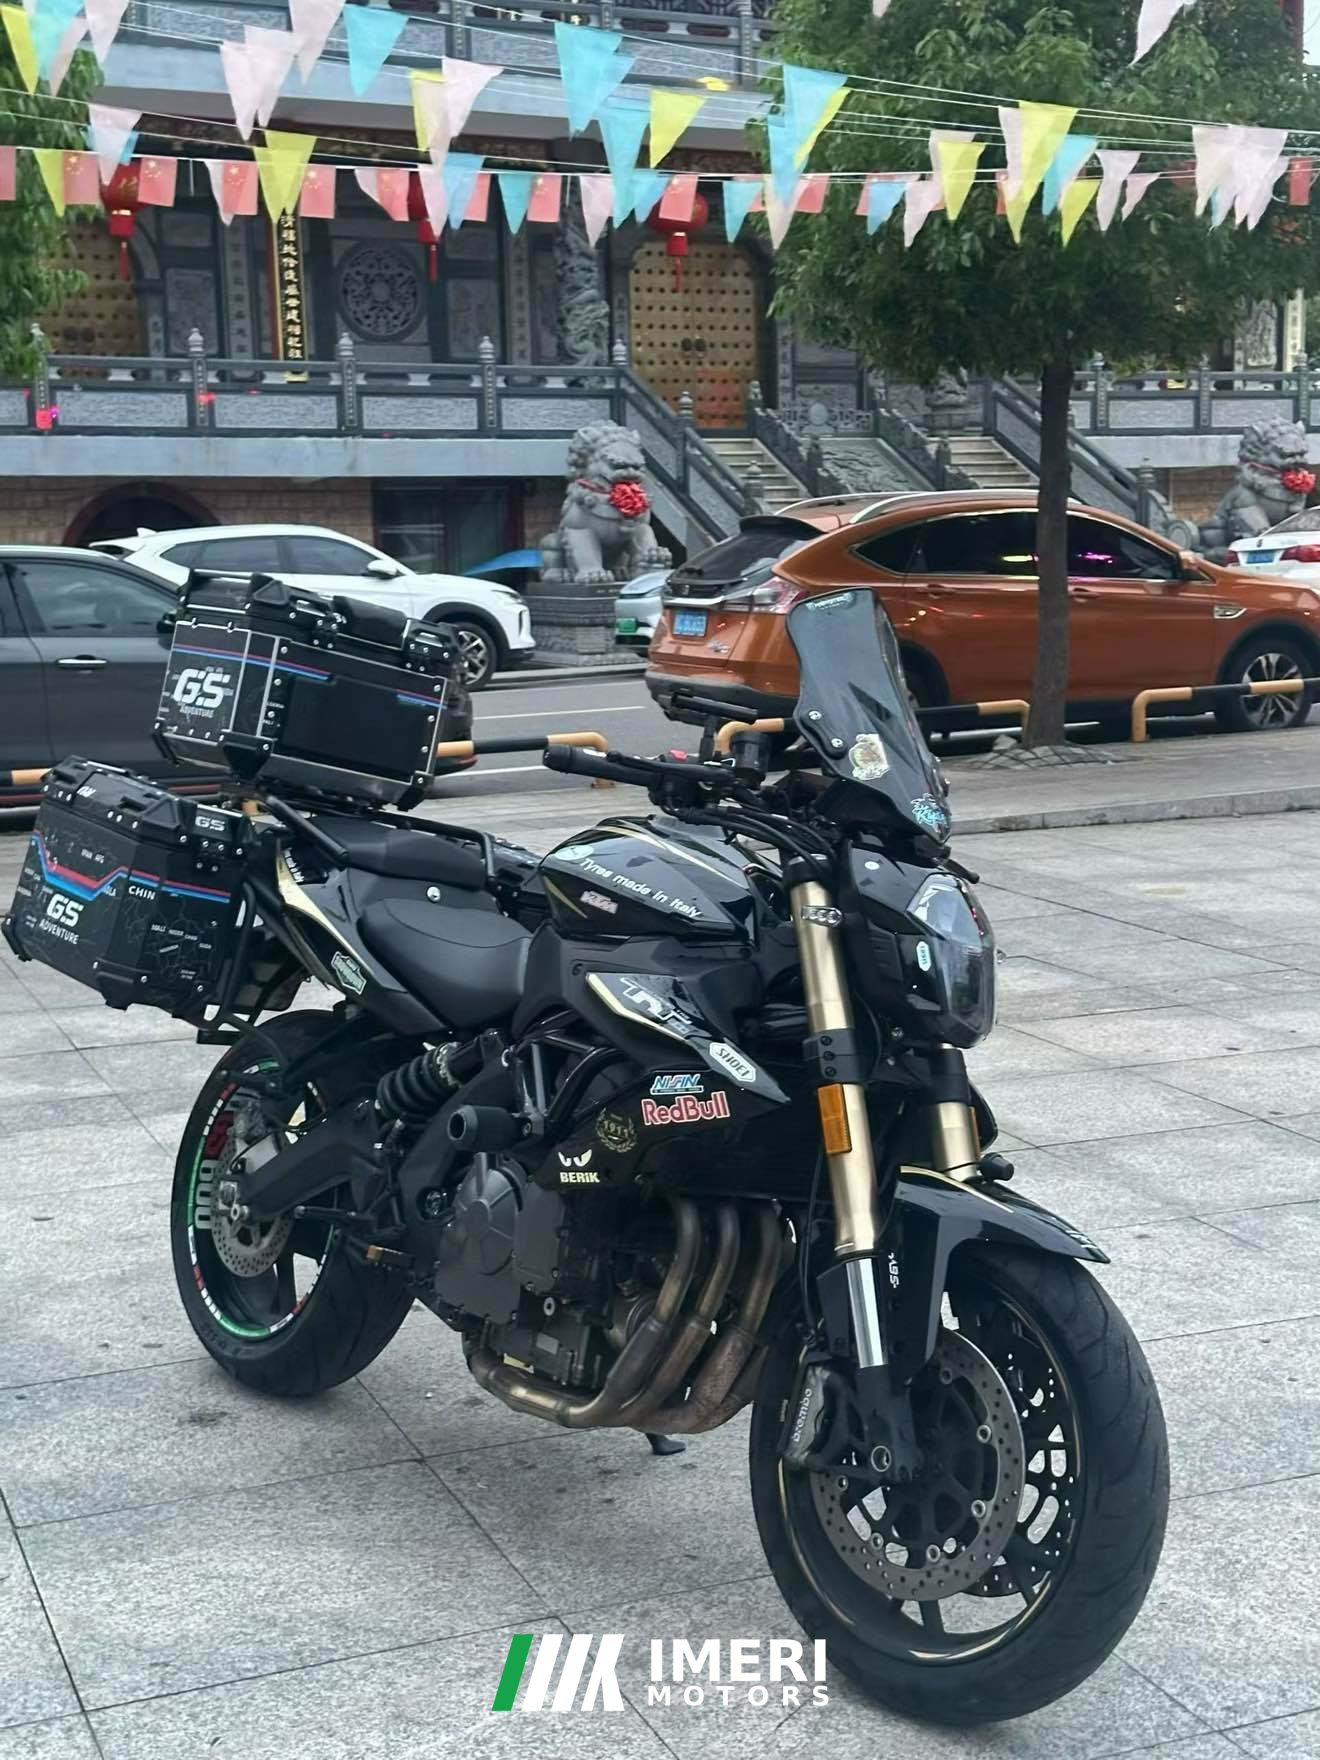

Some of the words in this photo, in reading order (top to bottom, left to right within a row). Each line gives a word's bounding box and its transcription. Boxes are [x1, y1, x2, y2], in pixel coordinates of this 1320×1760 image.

[172, 668, 231, 709] GS
[194, 815, 226, 832] GS
[128, 885, 156, 900] CHIN
[579, 858, 614, 878] Tyres
[612, 874, 651, 895] made
[652, 890, 669, 904] in
[669, 898, 702, 918] Italy
[46, 893, 85, 928] GS
[39, 918, 80, 945] ADVENTURE
[715, 1046, 752, 1078] SHOEI
[792, 1387, 813, 1442] brembo
